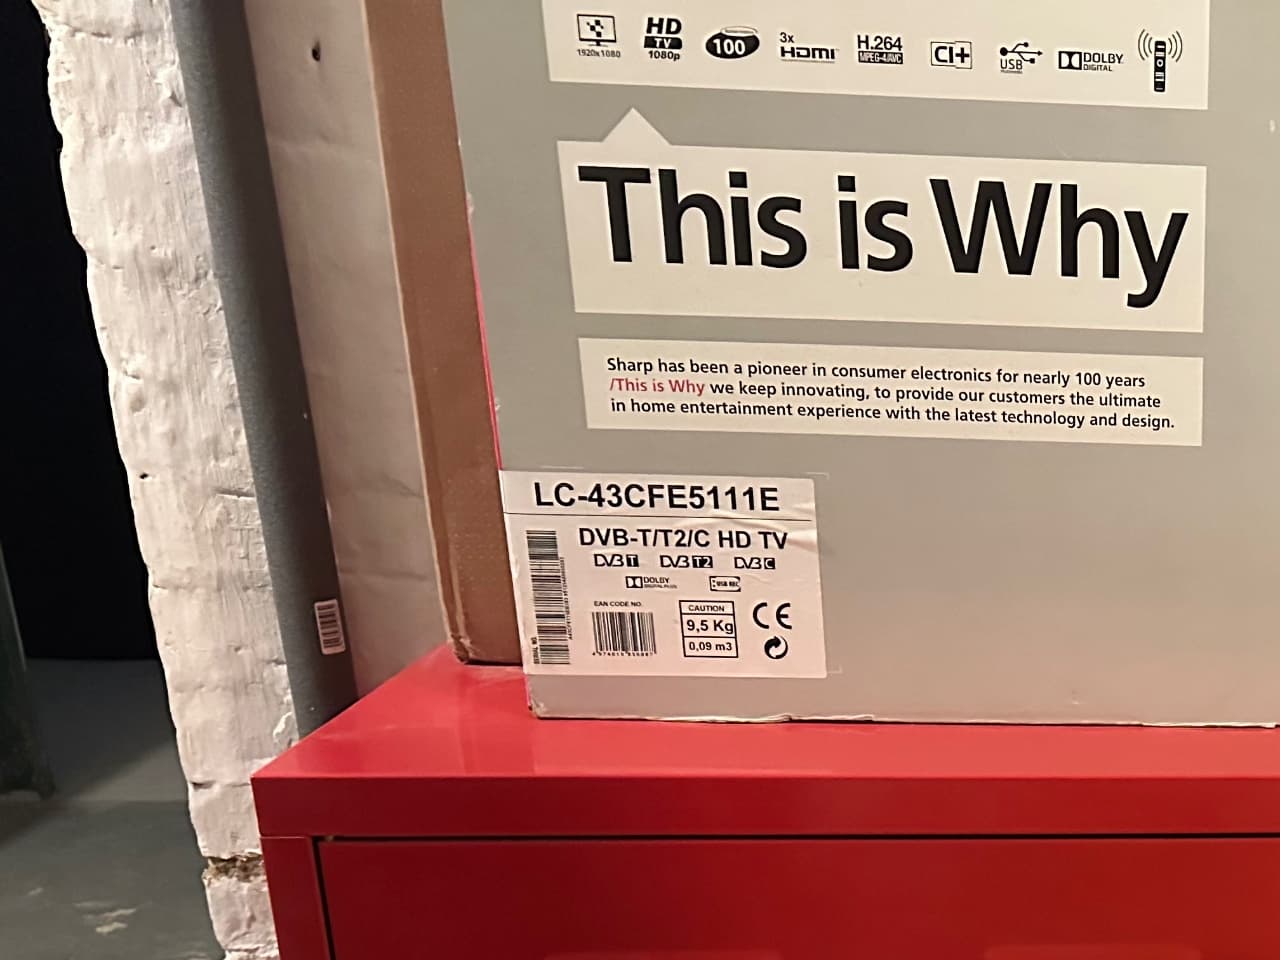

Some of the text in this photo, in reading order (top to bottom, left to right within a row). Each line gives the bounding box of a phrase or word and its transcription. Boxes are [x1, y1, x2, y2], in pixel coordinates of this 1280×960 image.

[646, 17, 682, 35] HD
[653, 37, 672, 48] TV
[779, 32, 794, 43] 3x
[857, 35, 903, 51] H.264
[577, 48, 621, 58] 1920x1080
[713, 38, 745, 55] 100
[780, 46, 836, 59] HDMI
[648, 50, 681, 61] 1080p
[934, 46, 970, 63] CI+
[1083, 52, 1123, 64] DOLBY
[1000, 58, 1023, 70] USB
[1083, 64, 1112, 72] DIGITAL
[578, 165, 1188, 308] This is Why
[607, 358, 1145, 389] Sharp has been a pioneer in consumer electronics for nearly 100 years
[609, 378, 1161, 408] /This is Why we keep innovating, to provide our customers the ultimate
[611, 398, 1175, 431] in home entertainment experience with the latest technology and design.
[534, 482, 780, 511] LC-43CFE5111E
[579, 528, 788, 549] DVB-T/T2/C HD TV
[687, 620, 734, 634] 9,5 Kg
[689, 642, 732, 652] 0,09 m3
